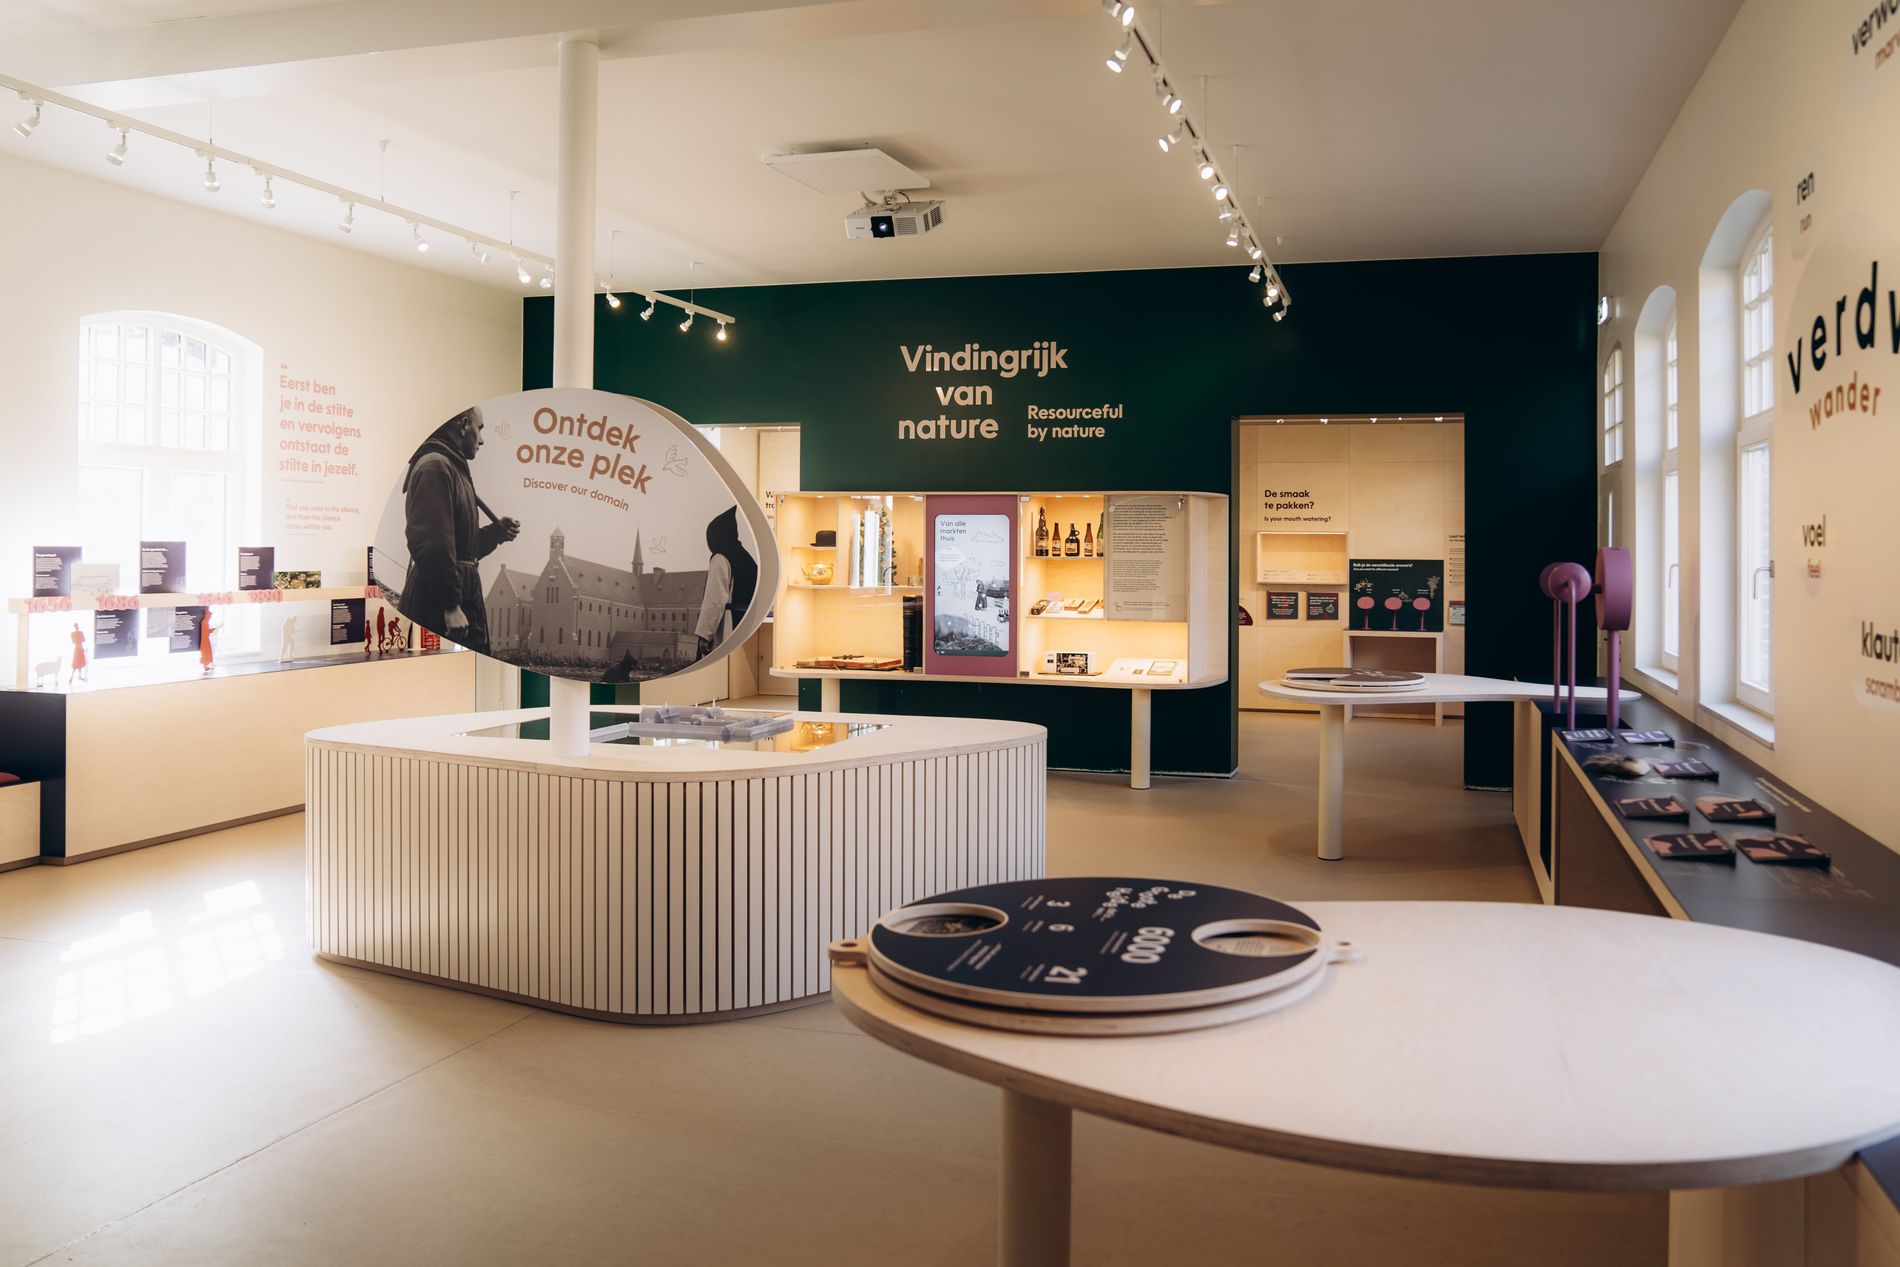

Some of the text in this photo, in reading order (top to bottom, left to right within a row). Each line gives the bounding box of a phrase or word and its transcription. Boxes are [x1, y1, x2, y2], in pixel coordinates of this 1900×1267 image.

[1796, 171, 1814, 205] ren
[900, 341, 1069, 378] Vindingrijk
[280, 374, 336, 396] Eerst ben
[935, 384, 993, 406] van
[279, 395, 354, 418] je in de stilte
[1027, 403, 1123, 420] Resourceful
[1809, 371, 1880, 431] wander
[280, 419, 362, 440] en vervolgens
[533, 407, 641, 454] Ontdek
[898, 414, 999, 440] nature
[1027, 423, 1106, 442] by nature
[279, 439, 349, 456] ontstaat de
[279, 458, 358, 477] stilte in jezelf.
[516, 443, 653, 494] onze plek
[523, 477, 629, 511] Discover our domain
[1264, 489, 1310, 498] De smaak
[1264, 501, 1315, 511] te pakken?
[1802, 514, 1826, 547] voel
[1807, 557, 1822, 579] feel
[24, 596, 72, 614] 1656
[95, 594, 140, 611] 1686
[1120, 926, 1175, 964] 6000
[1044, 965, 1088, 984] 21
